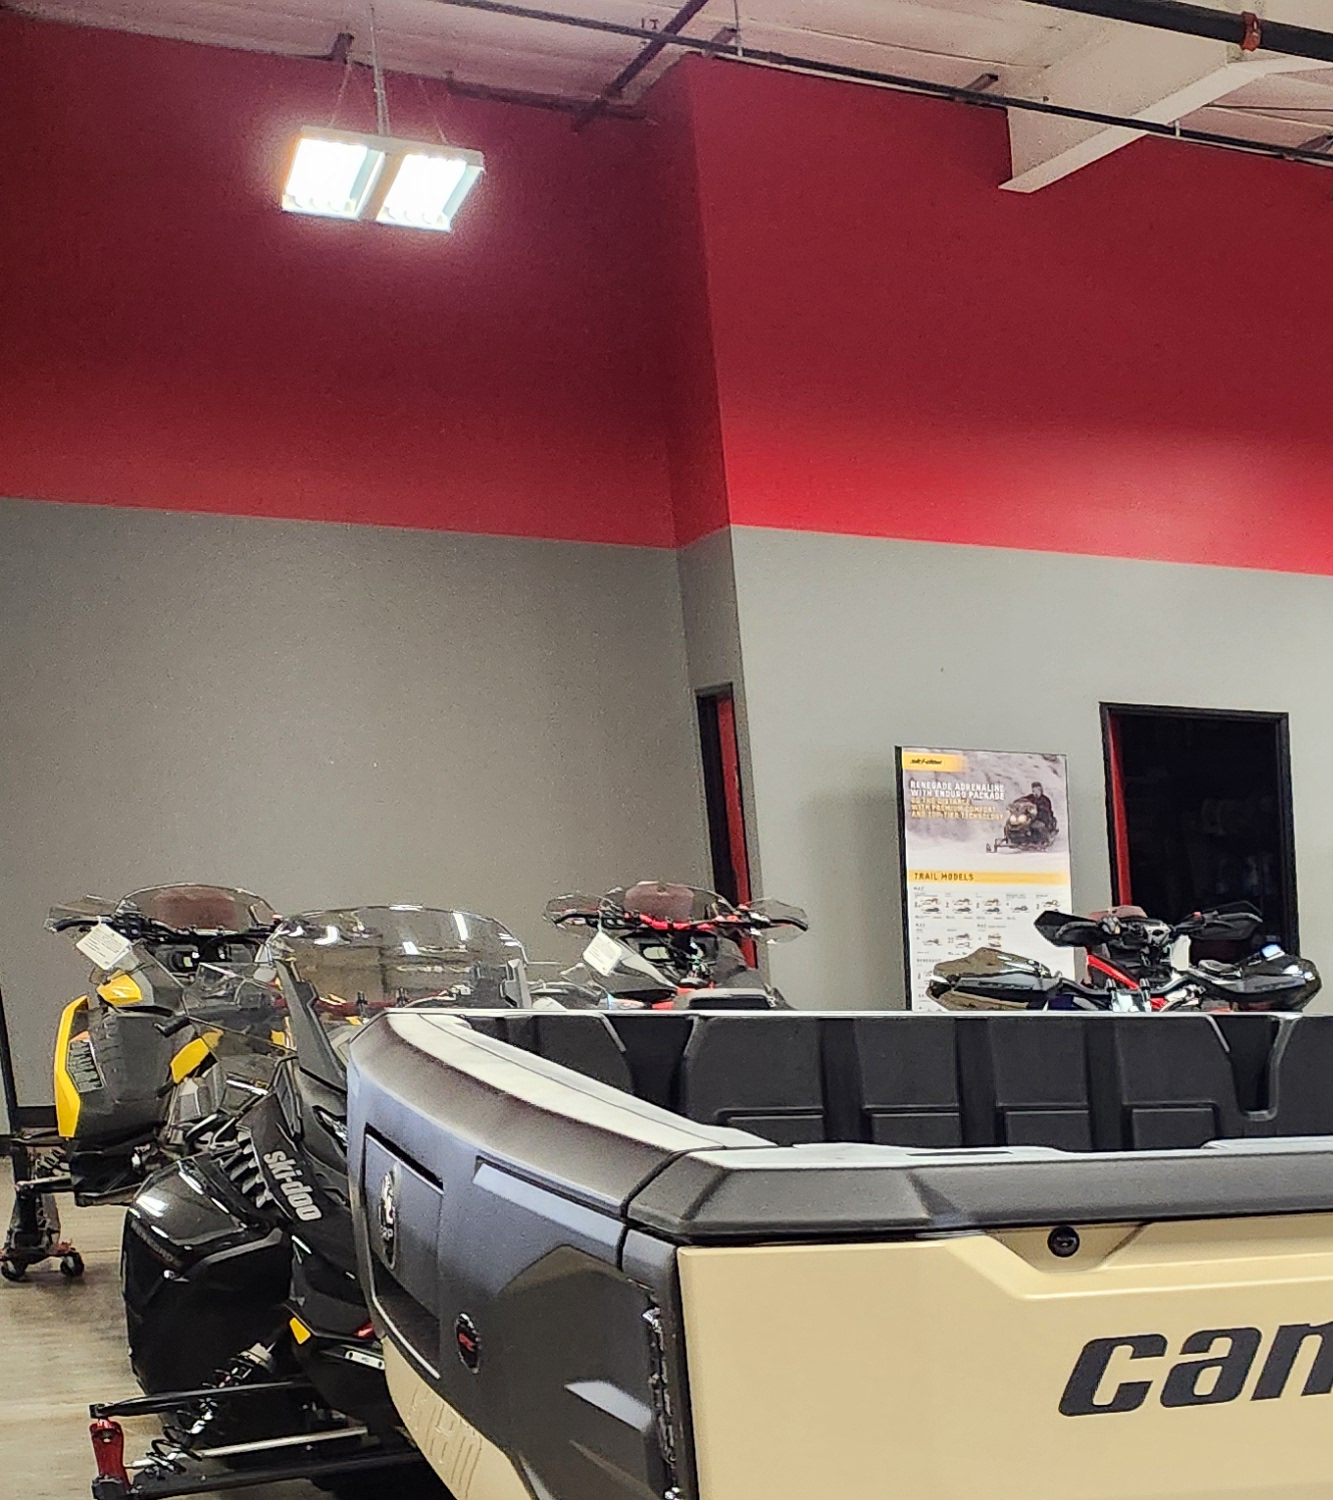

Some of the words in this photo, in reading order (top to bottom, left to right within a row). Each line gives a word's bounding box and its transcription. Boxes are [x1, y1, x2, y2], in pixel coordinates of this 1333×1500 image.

[910, 780, 953, 790] RENEGADE
[955, 783, 1005, 793] ADRENALINE
[911, 789, 933, 797] WITH
[969, 791, 1005, 800] PACKAGE
[914, 872, 938, 881] TRAIL
[940, 873, 975, 882] MODELS
[263, 1150, 323, 1222] ski-doo
